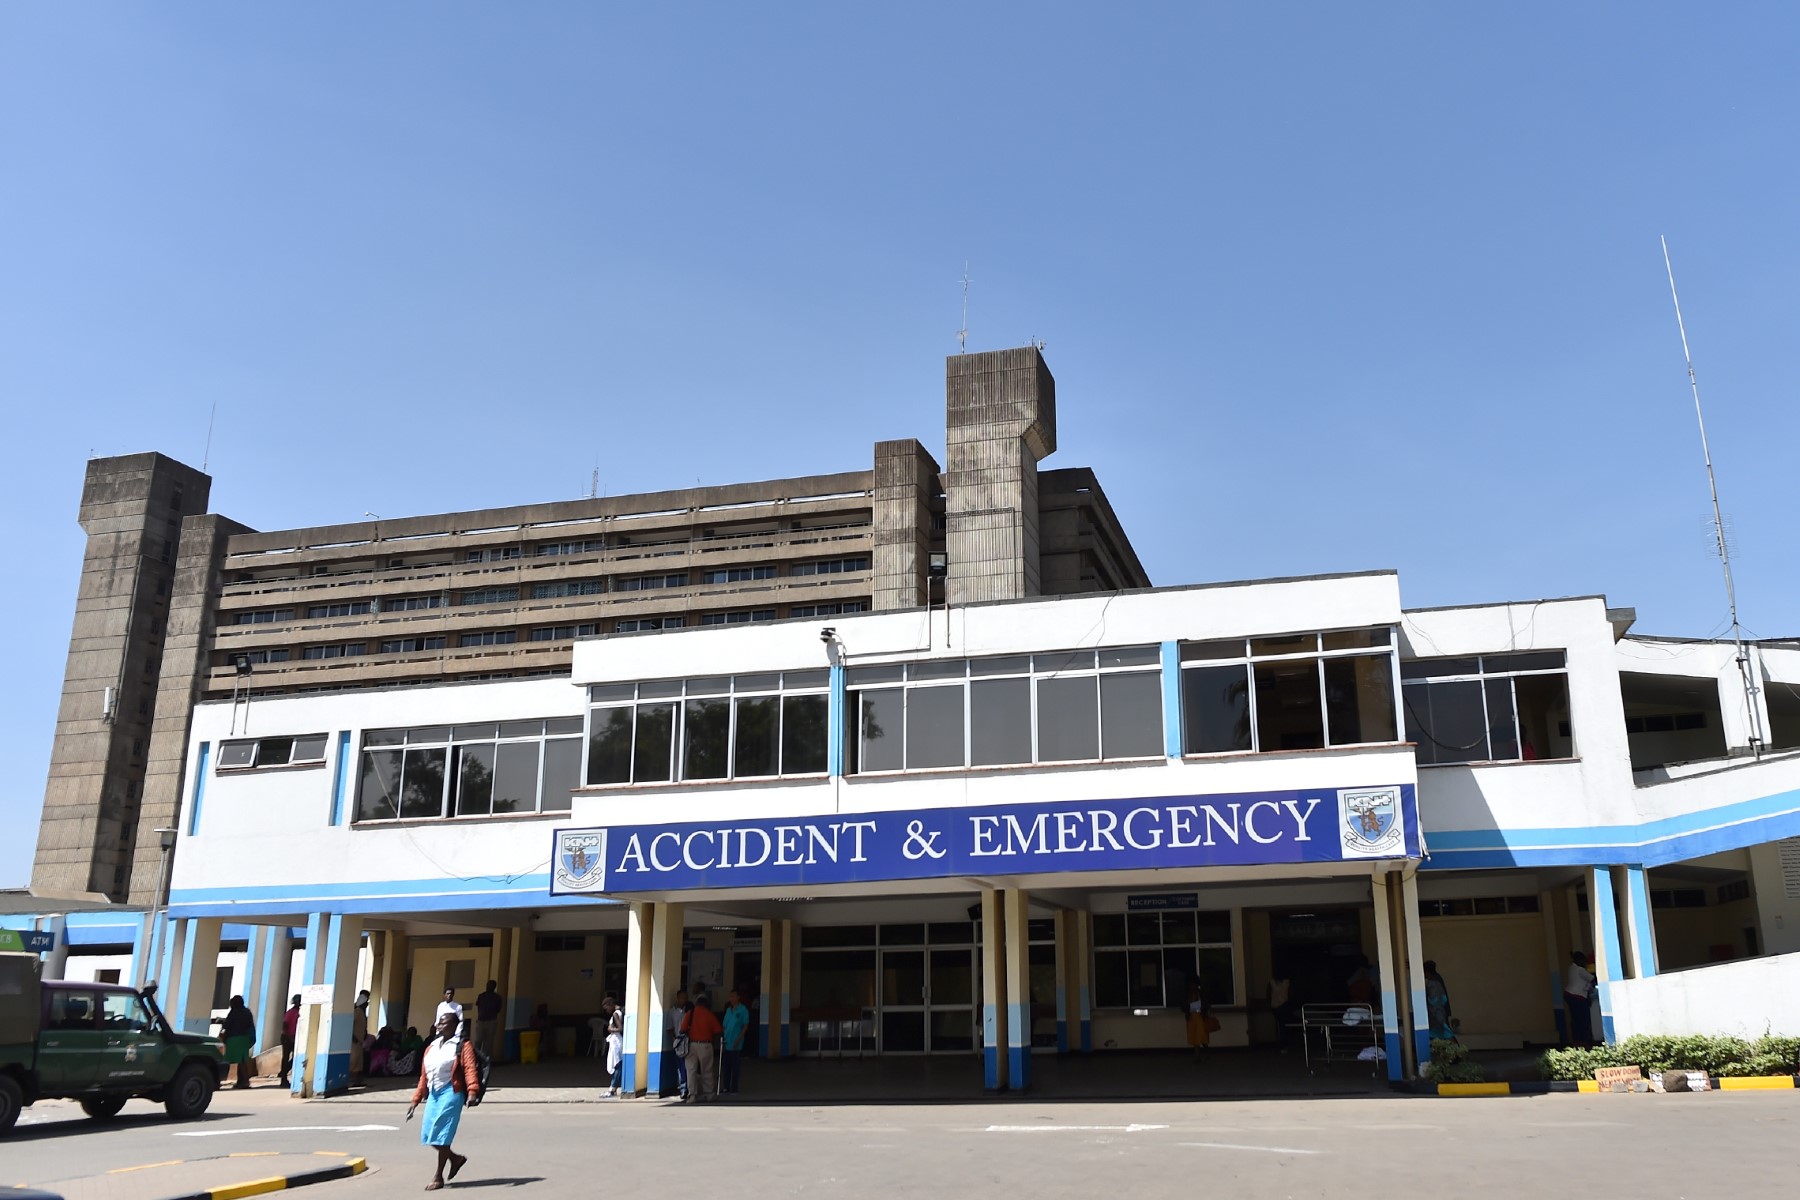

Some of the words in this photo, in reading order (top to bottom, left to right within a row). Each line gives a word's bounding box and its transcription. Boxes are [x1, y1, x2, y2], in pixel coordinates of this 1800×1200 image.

[1347, 795, 1391, 807] KNH
[614, 820, 877, 873] ACCIDENT
[902, 819, 947, 860] &
[968, 798, 1321, 857] EMERGENCY
[564, 837, 599, 847] KNH
[1130, 898, 1167, 906] RECEPTION
[31, 936, 50, 946] ATM
[1600, 1069, 1621, 1079] SLOW
